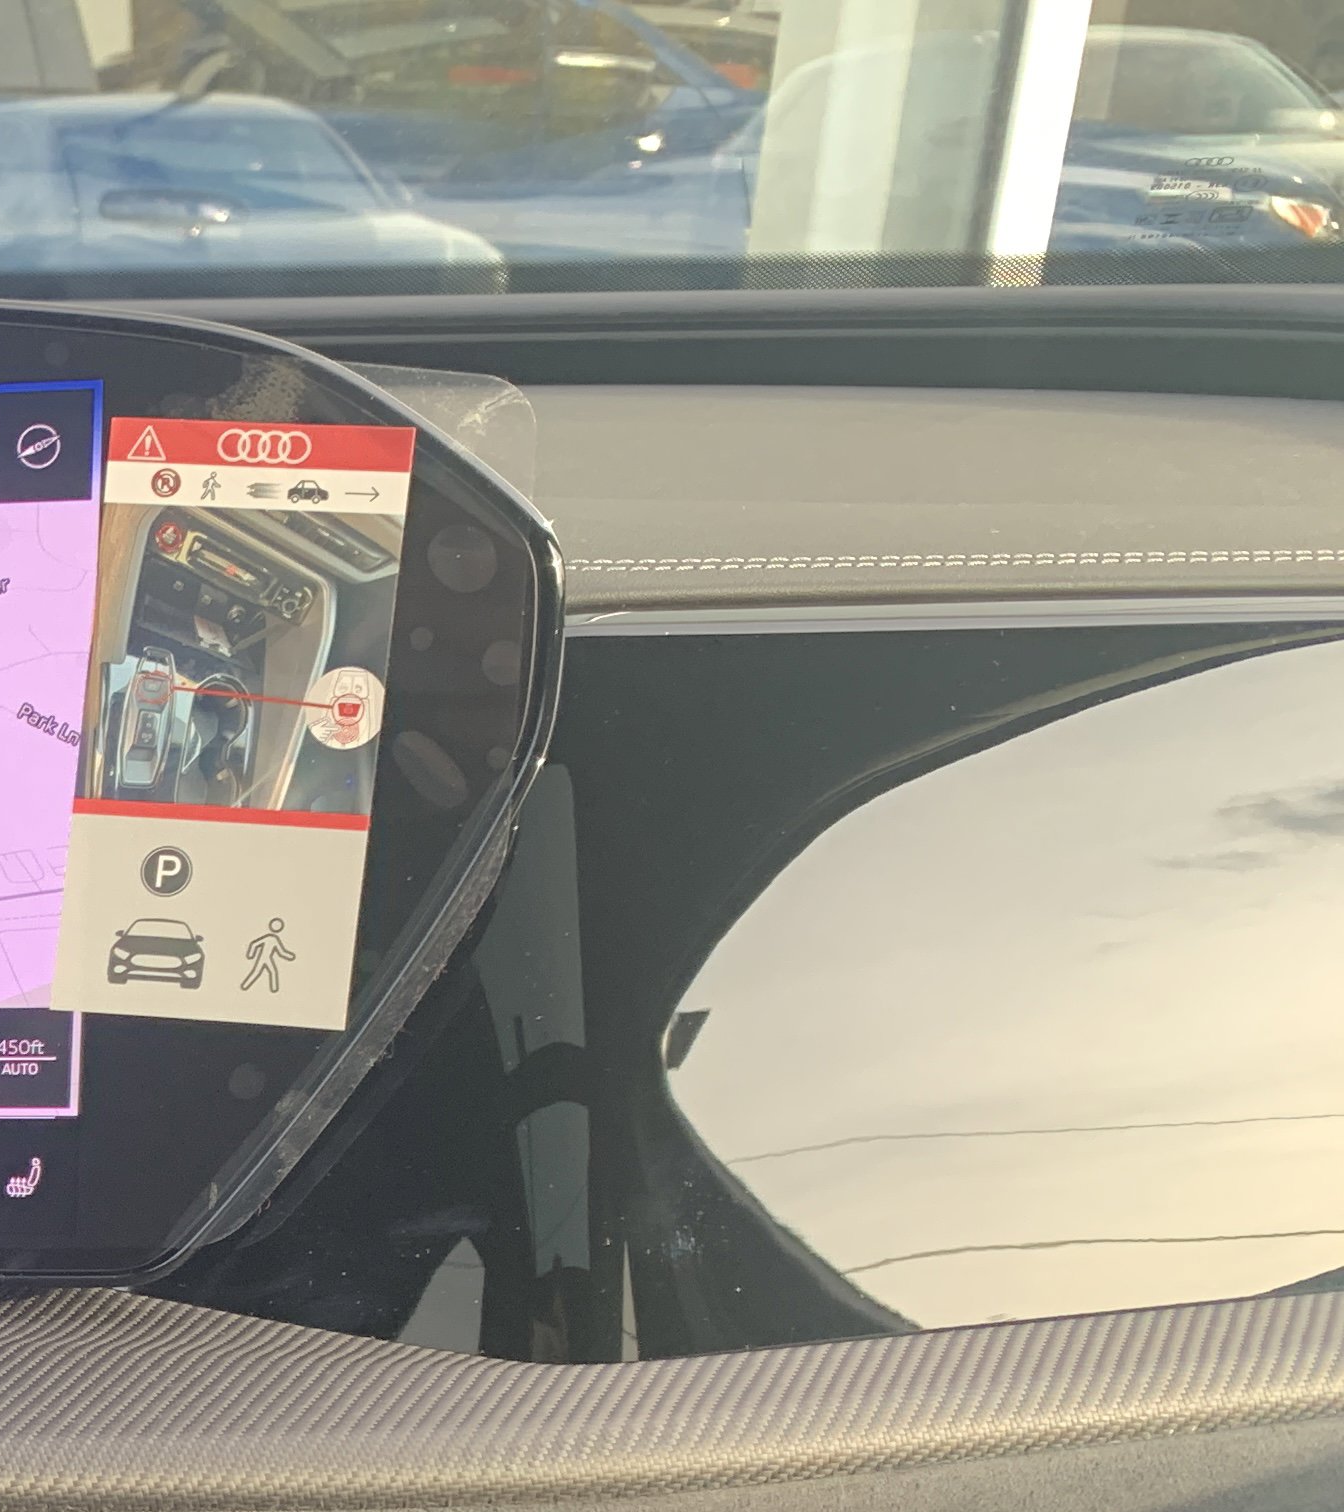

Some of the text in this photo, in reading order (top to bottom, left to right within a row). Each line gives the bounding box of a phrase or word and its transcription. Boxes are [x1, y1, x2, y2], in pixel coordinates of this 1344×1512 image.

[17, 702, 81, 746] Park Ln
[1, 1062, 39, 1077] AUTO
